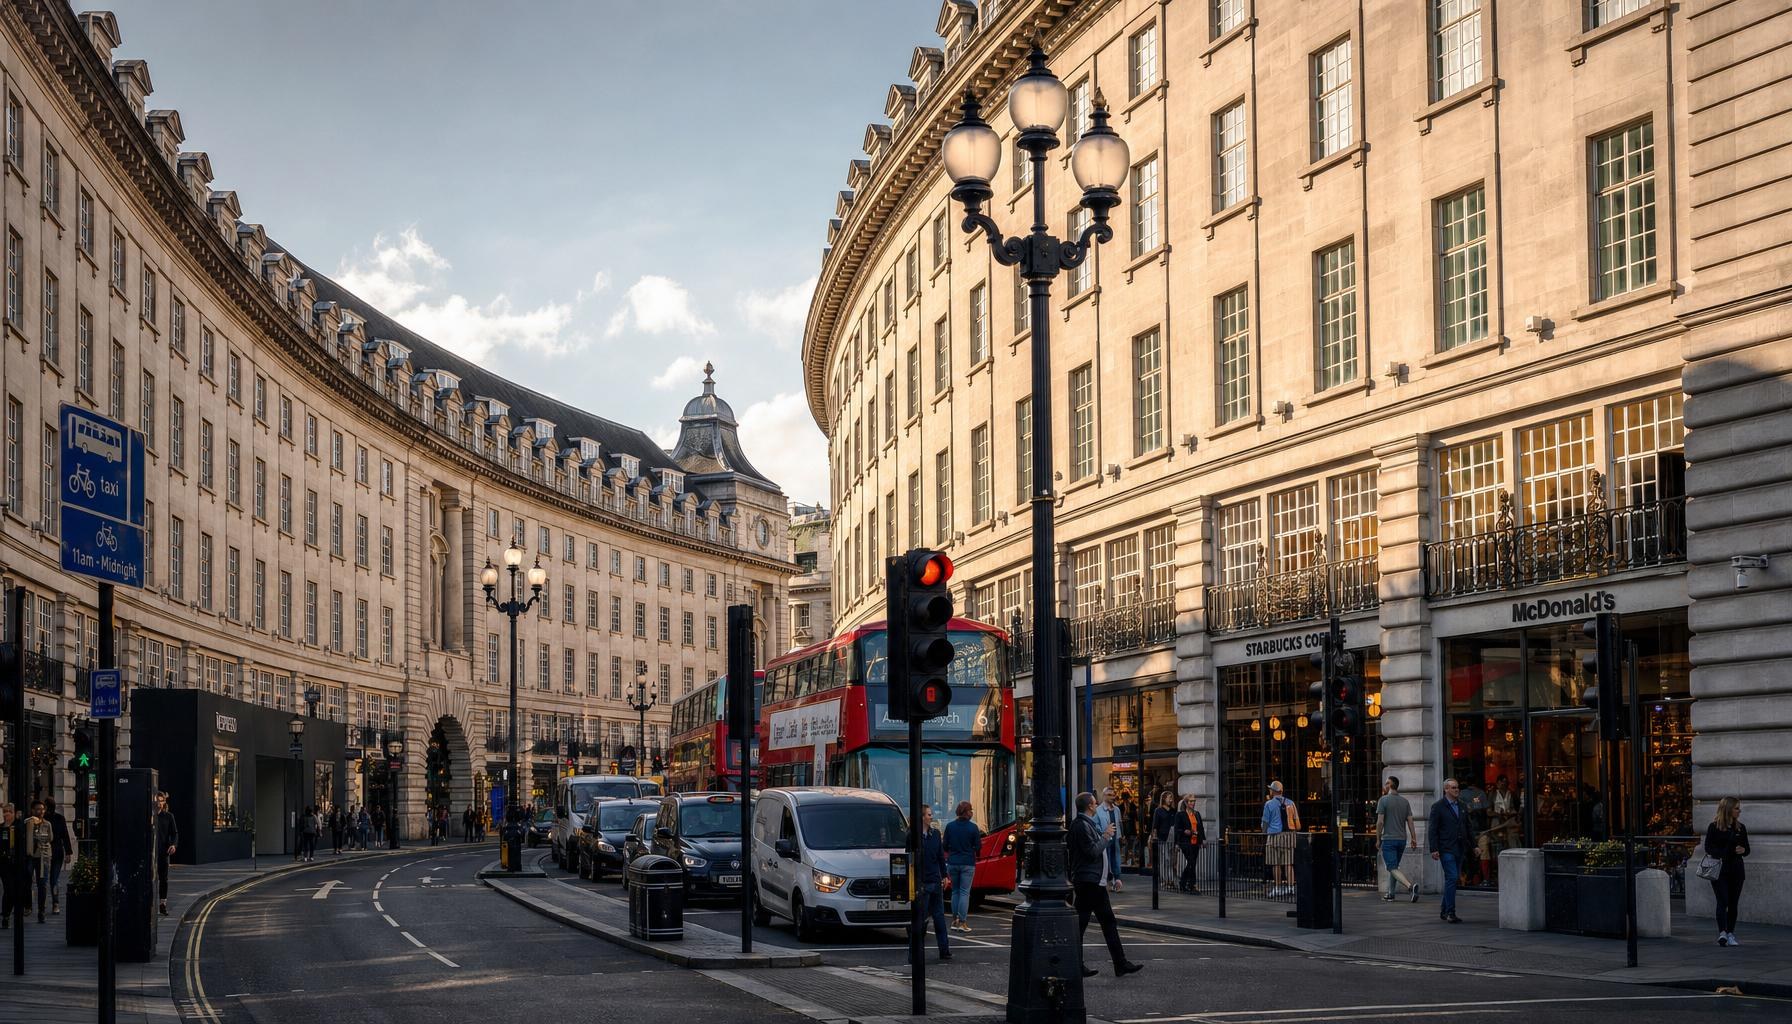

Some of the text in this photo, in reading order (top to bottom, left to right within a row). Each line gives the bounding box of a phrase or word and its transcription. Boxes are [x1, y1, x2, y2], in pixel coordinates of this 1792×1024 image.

[101, 476, 119, 497] taxi
[72, 547, 94, 568] 11am
[101, 555, 137, 580] Midnight
[1512, 590, 1616, 622] McDonald's
[1245, 635, 1303, 657] STARBUCKS
[978, 710, 988, 726] 6
